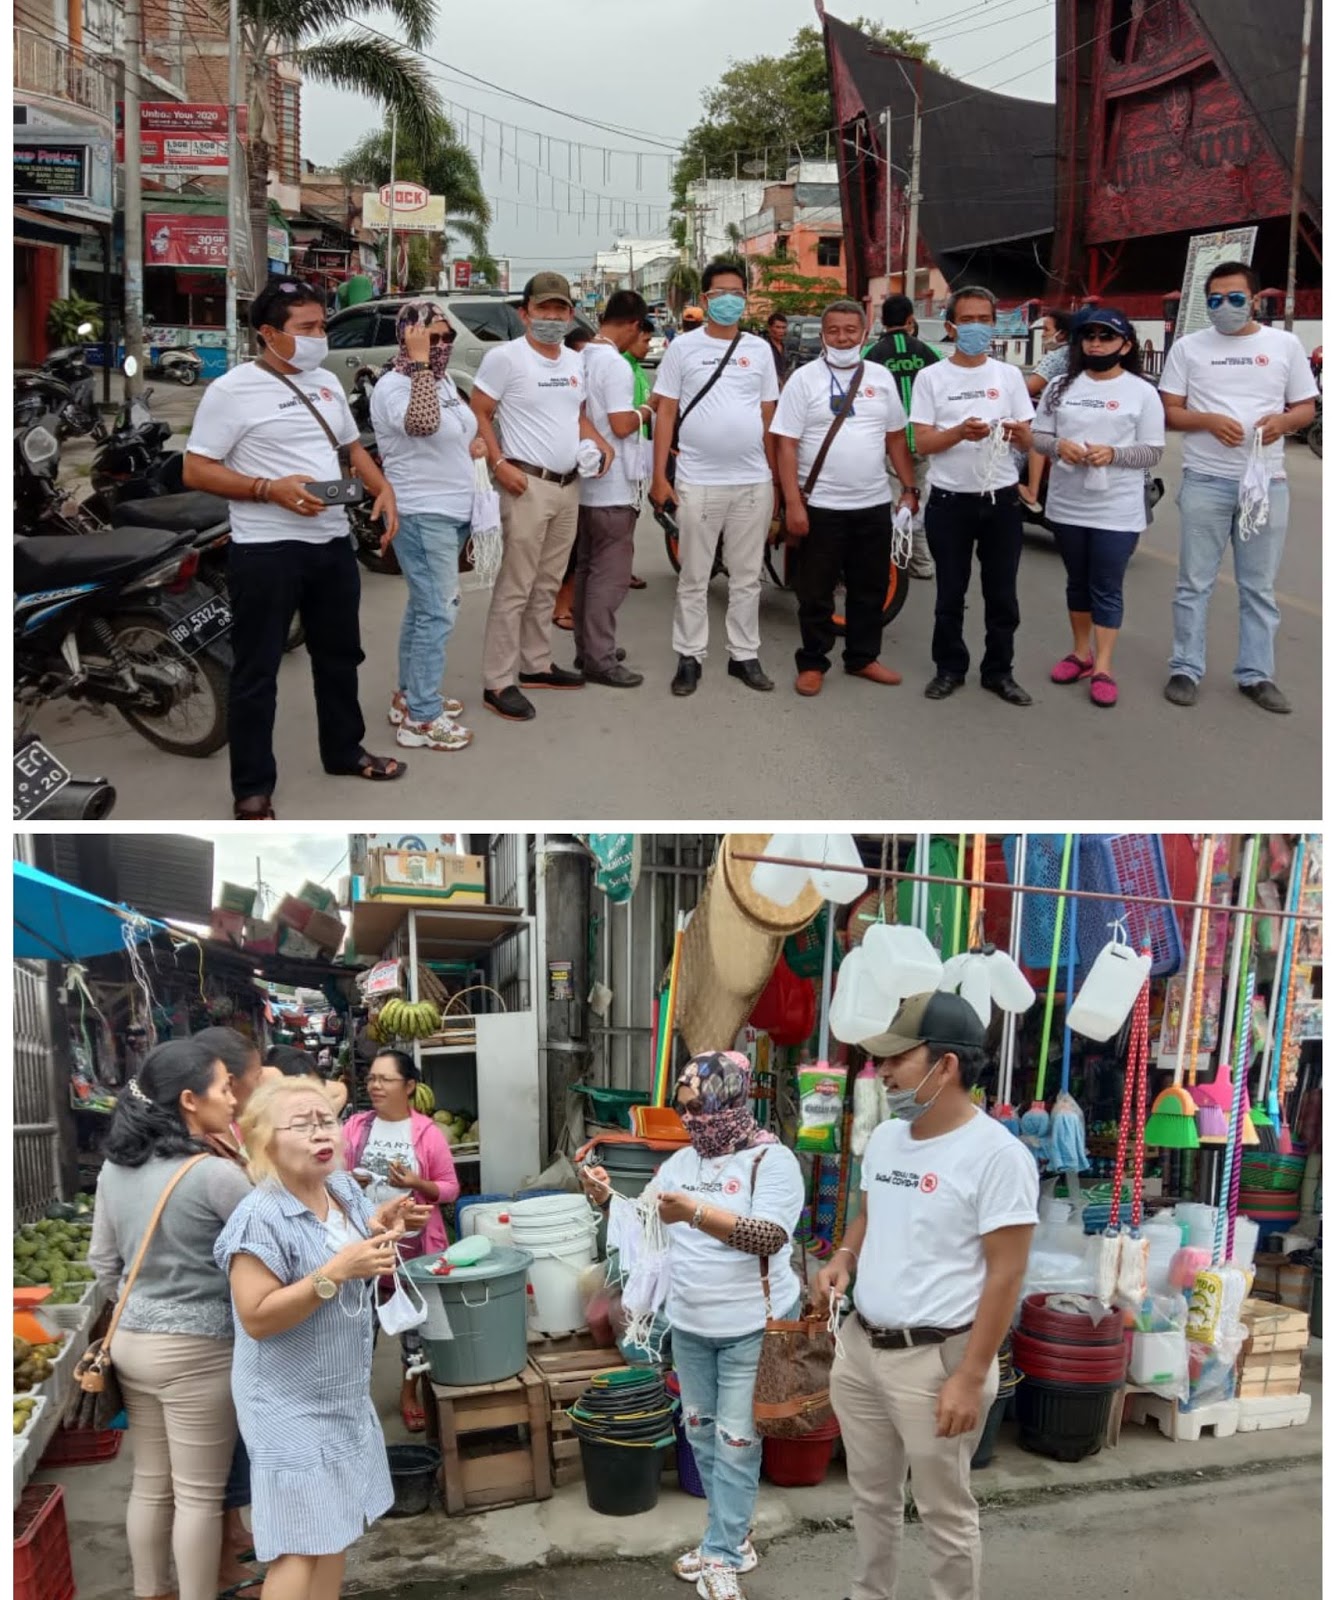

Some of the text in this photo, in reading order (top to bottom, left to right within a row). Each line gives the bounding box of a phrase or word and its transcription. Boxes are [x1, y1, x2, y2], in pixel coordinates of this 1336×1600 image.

[885, 354, 925, 371] Grab
[171, 624, 190, 642] BB
[367, 1140, 412, 1149] KART
